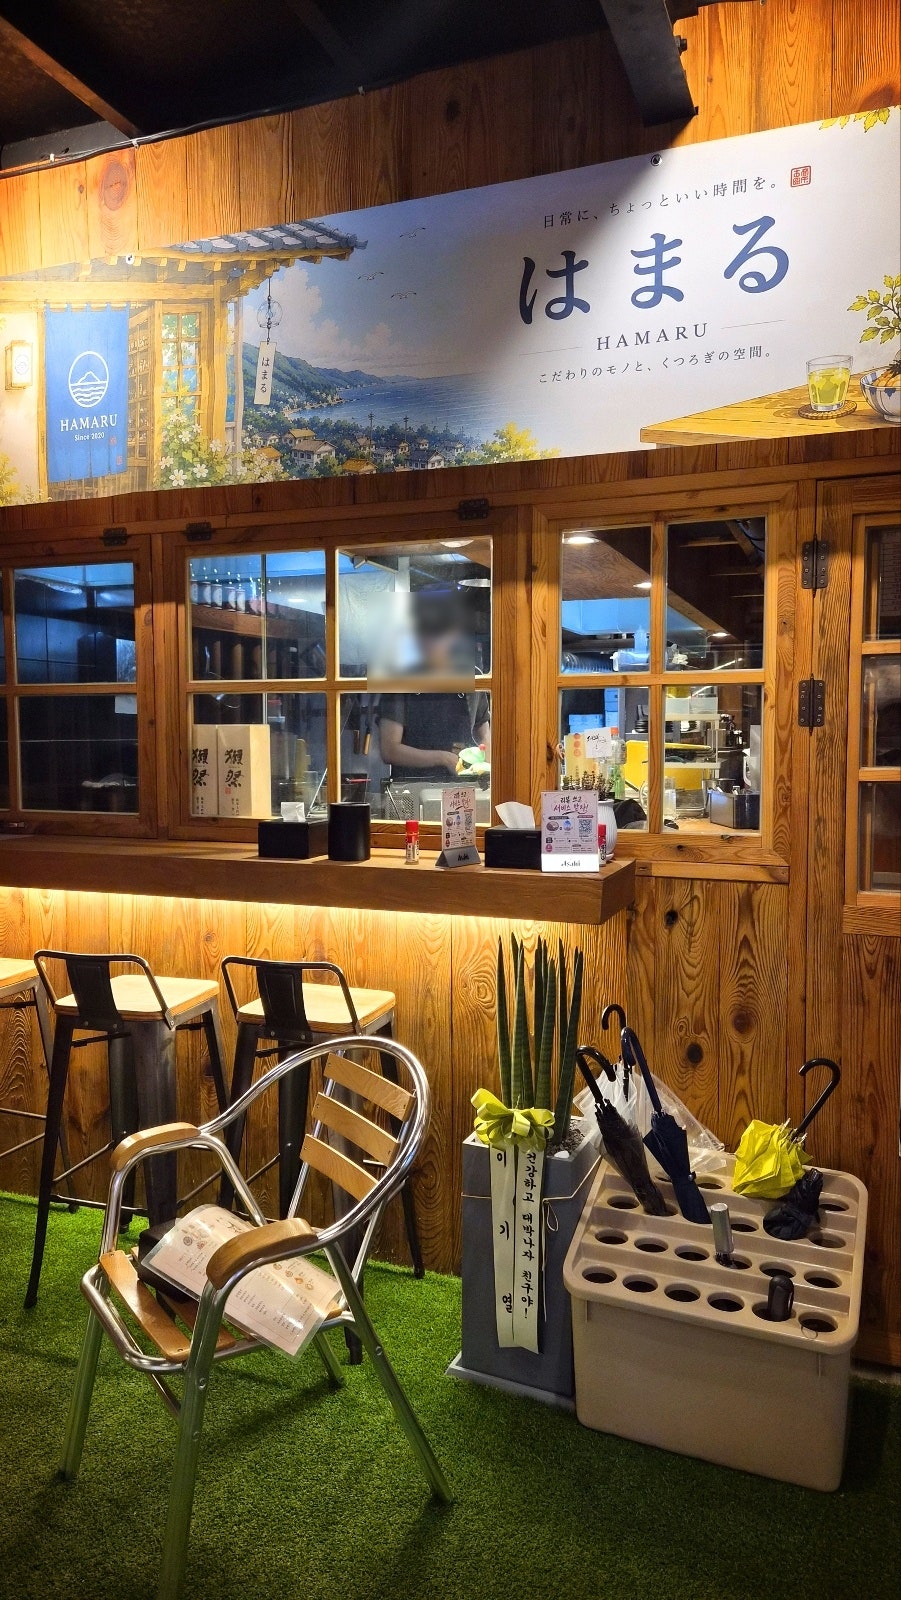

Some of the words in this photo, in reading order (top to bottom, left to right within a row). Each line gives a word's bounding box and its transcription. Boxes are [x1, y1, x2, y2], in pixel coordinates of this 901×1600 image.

[543, 176, 776, 229] 日常に、ちょっといい時間を。
[519, 215, 790, 325] はまる
[596, 322, 709, 351] HAMARU
[259, 355, 271, 395] はまる
[538, 345, 773, 384] こだわりのモノと、くつろぎの空間。
[60, 413, 118, 432] HAMARU
[74, 433, 90, 442] Since
[91, 431, 105, 441] 2020
[553, 803, 571, 812] 서비스
[522, 1152, 538, 1203] 건강하고
[521, 1212, 536, 1262] 대박나자
[521, 1270, 534, 1319] 친구야!
